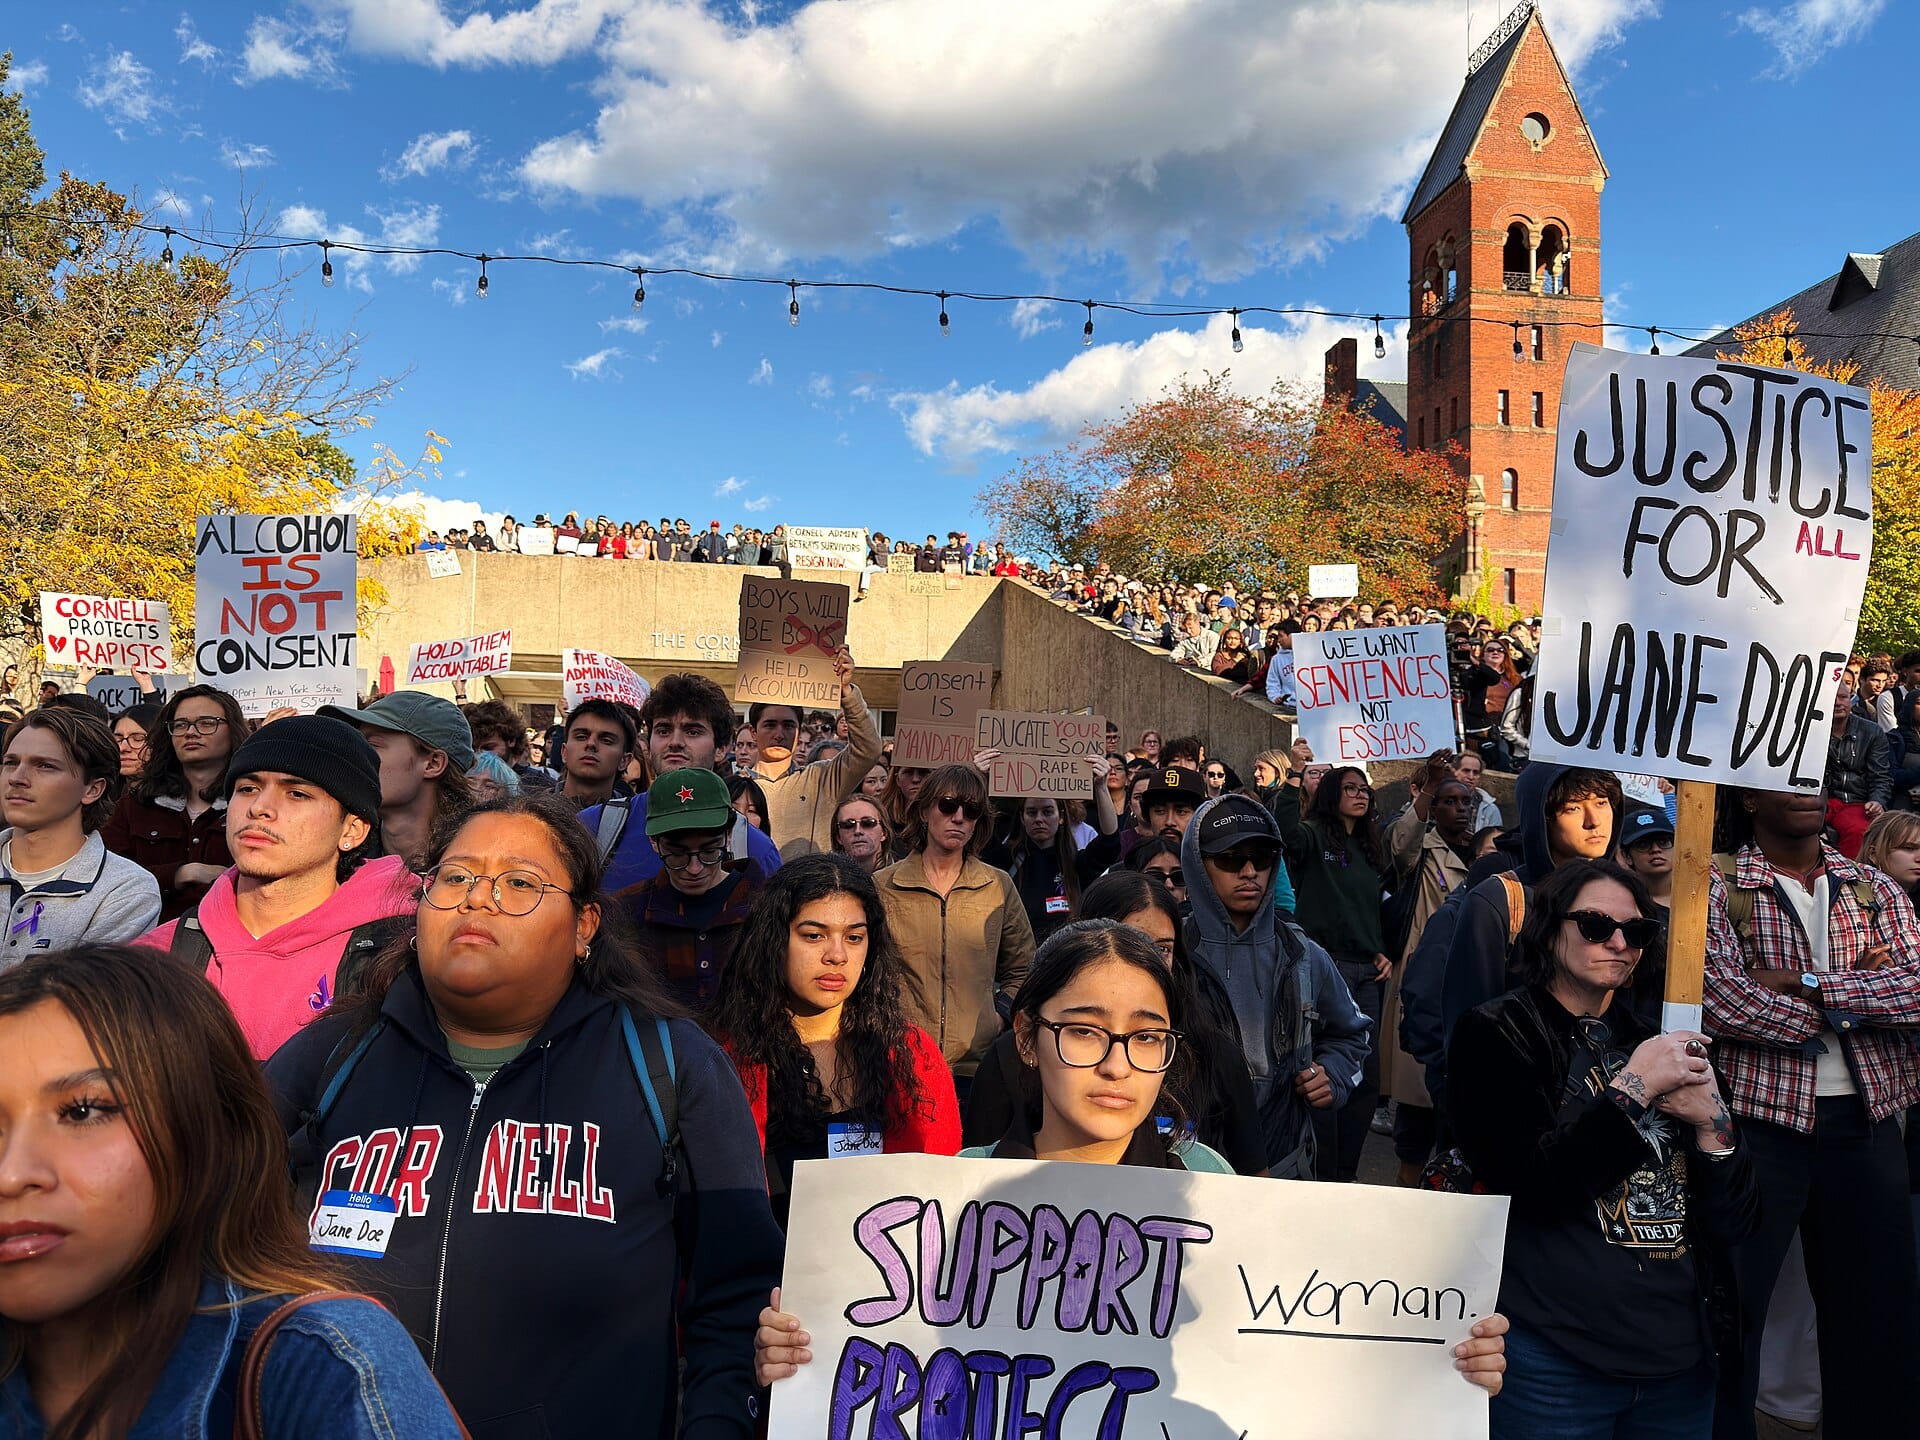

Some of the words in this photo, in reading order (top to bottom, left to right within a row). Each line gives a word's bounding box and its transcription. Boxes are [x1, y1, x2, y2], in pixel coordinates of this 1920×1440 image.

[1574, 364, 1869, 521] JUSTICE
[196, 515, 356, 555] ALCOHOL
[790, 528, 823, 538] CORNELL
[1795, 520, 1860, 560] ALL
[795, 555, 825, 567] RESIGN
[1623, 497, 1784, 605] FOR
[242, 554, 321, 590] IS
[56, 598, 160, 622] CORNELL
[221, 591, 343, 636] NOT
[747, 584, 799, 615] BOYS
[805, 592, 844, 619] WILL
[69, 618, 159, 639] PROTECTS
[651, 632, 686, 648] THE
[744, 617, 773, 641] BE
[782, 621, 836, 649] BOYS
[75, 638, 167, 669] RAPISTS
[196, 633, 356, 676] CONSENT
[417, 641, 463, 662] HOLD
[470, 630, 510, 653] THEM
[573, 653, 599, 665] THE
[1321, 637, 1359, 659] WE
[1364, 632, 1419, 656] WANT
[411, 653, 508, 682] ACCOUNTABLE
[766, 659, 808, 678] HELD
[903, 667, 986, 691] Consent
[1296, 654, 1449, 709] SENTENCES
[98, 688, 126, 707] OCK
[265, 685, 284, 696] New
[289, 683, 308, 694] York
[576, 683, 590, 694] IS
[595, 682, 614, 693] AN
[738, 672, 839, 701] ACCOUNTABLE
[1544, 622, 1727, 767] JANE
[931, 696, 954, 716] IS
[1360, 701, 1392, 723] NOT
[978, 716, 1051, 748] EDUCATE
[1053, 720, 1101, 738] YOUR
[1339, 722, 1426, 760] ESSAYS
[1056, 738, 1105, 756] SONS
[993, 761, 1037, 792] END
[1040, 760, 1079, 774] RAPE
[1038, 777, 1091, 792] CULTURE
[834, 1139, 862, 1152] Jane
[348, 1193, 372, 1204] Hello
[319, 1213, 353, 1239] Jane
[357, 1219, 384, 1242] Doe
[845, 1197, 1213, 1337] SUPPORT
[1239, 1264, 1478, 1325] Woman.
[828, 1336, 1159, 1440] PROTECT
